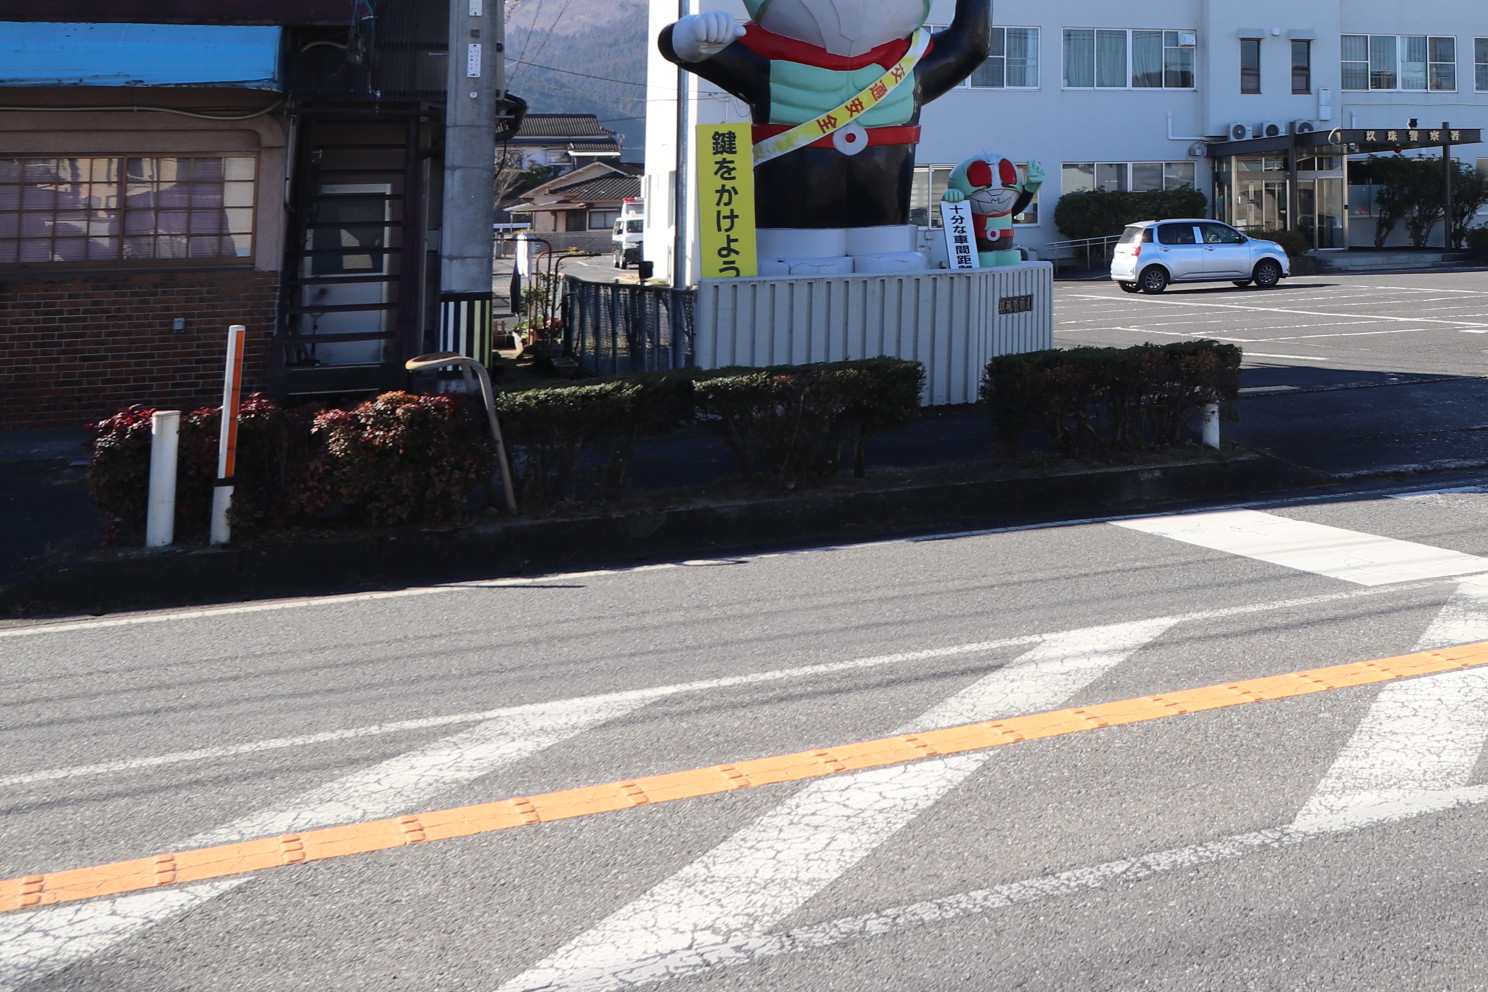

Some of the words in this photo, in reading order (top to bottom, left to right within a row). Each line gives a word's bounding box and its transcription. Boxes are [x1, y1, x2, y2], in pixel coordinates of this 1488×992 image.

[816, 63, 906, 134] 交通安全
[1366, 130, 1460, 141] 玖珠警察署
[711, 130, 741, 278] 鍵をかけよう
[949, 204, 973, 269] 十分な車間距
